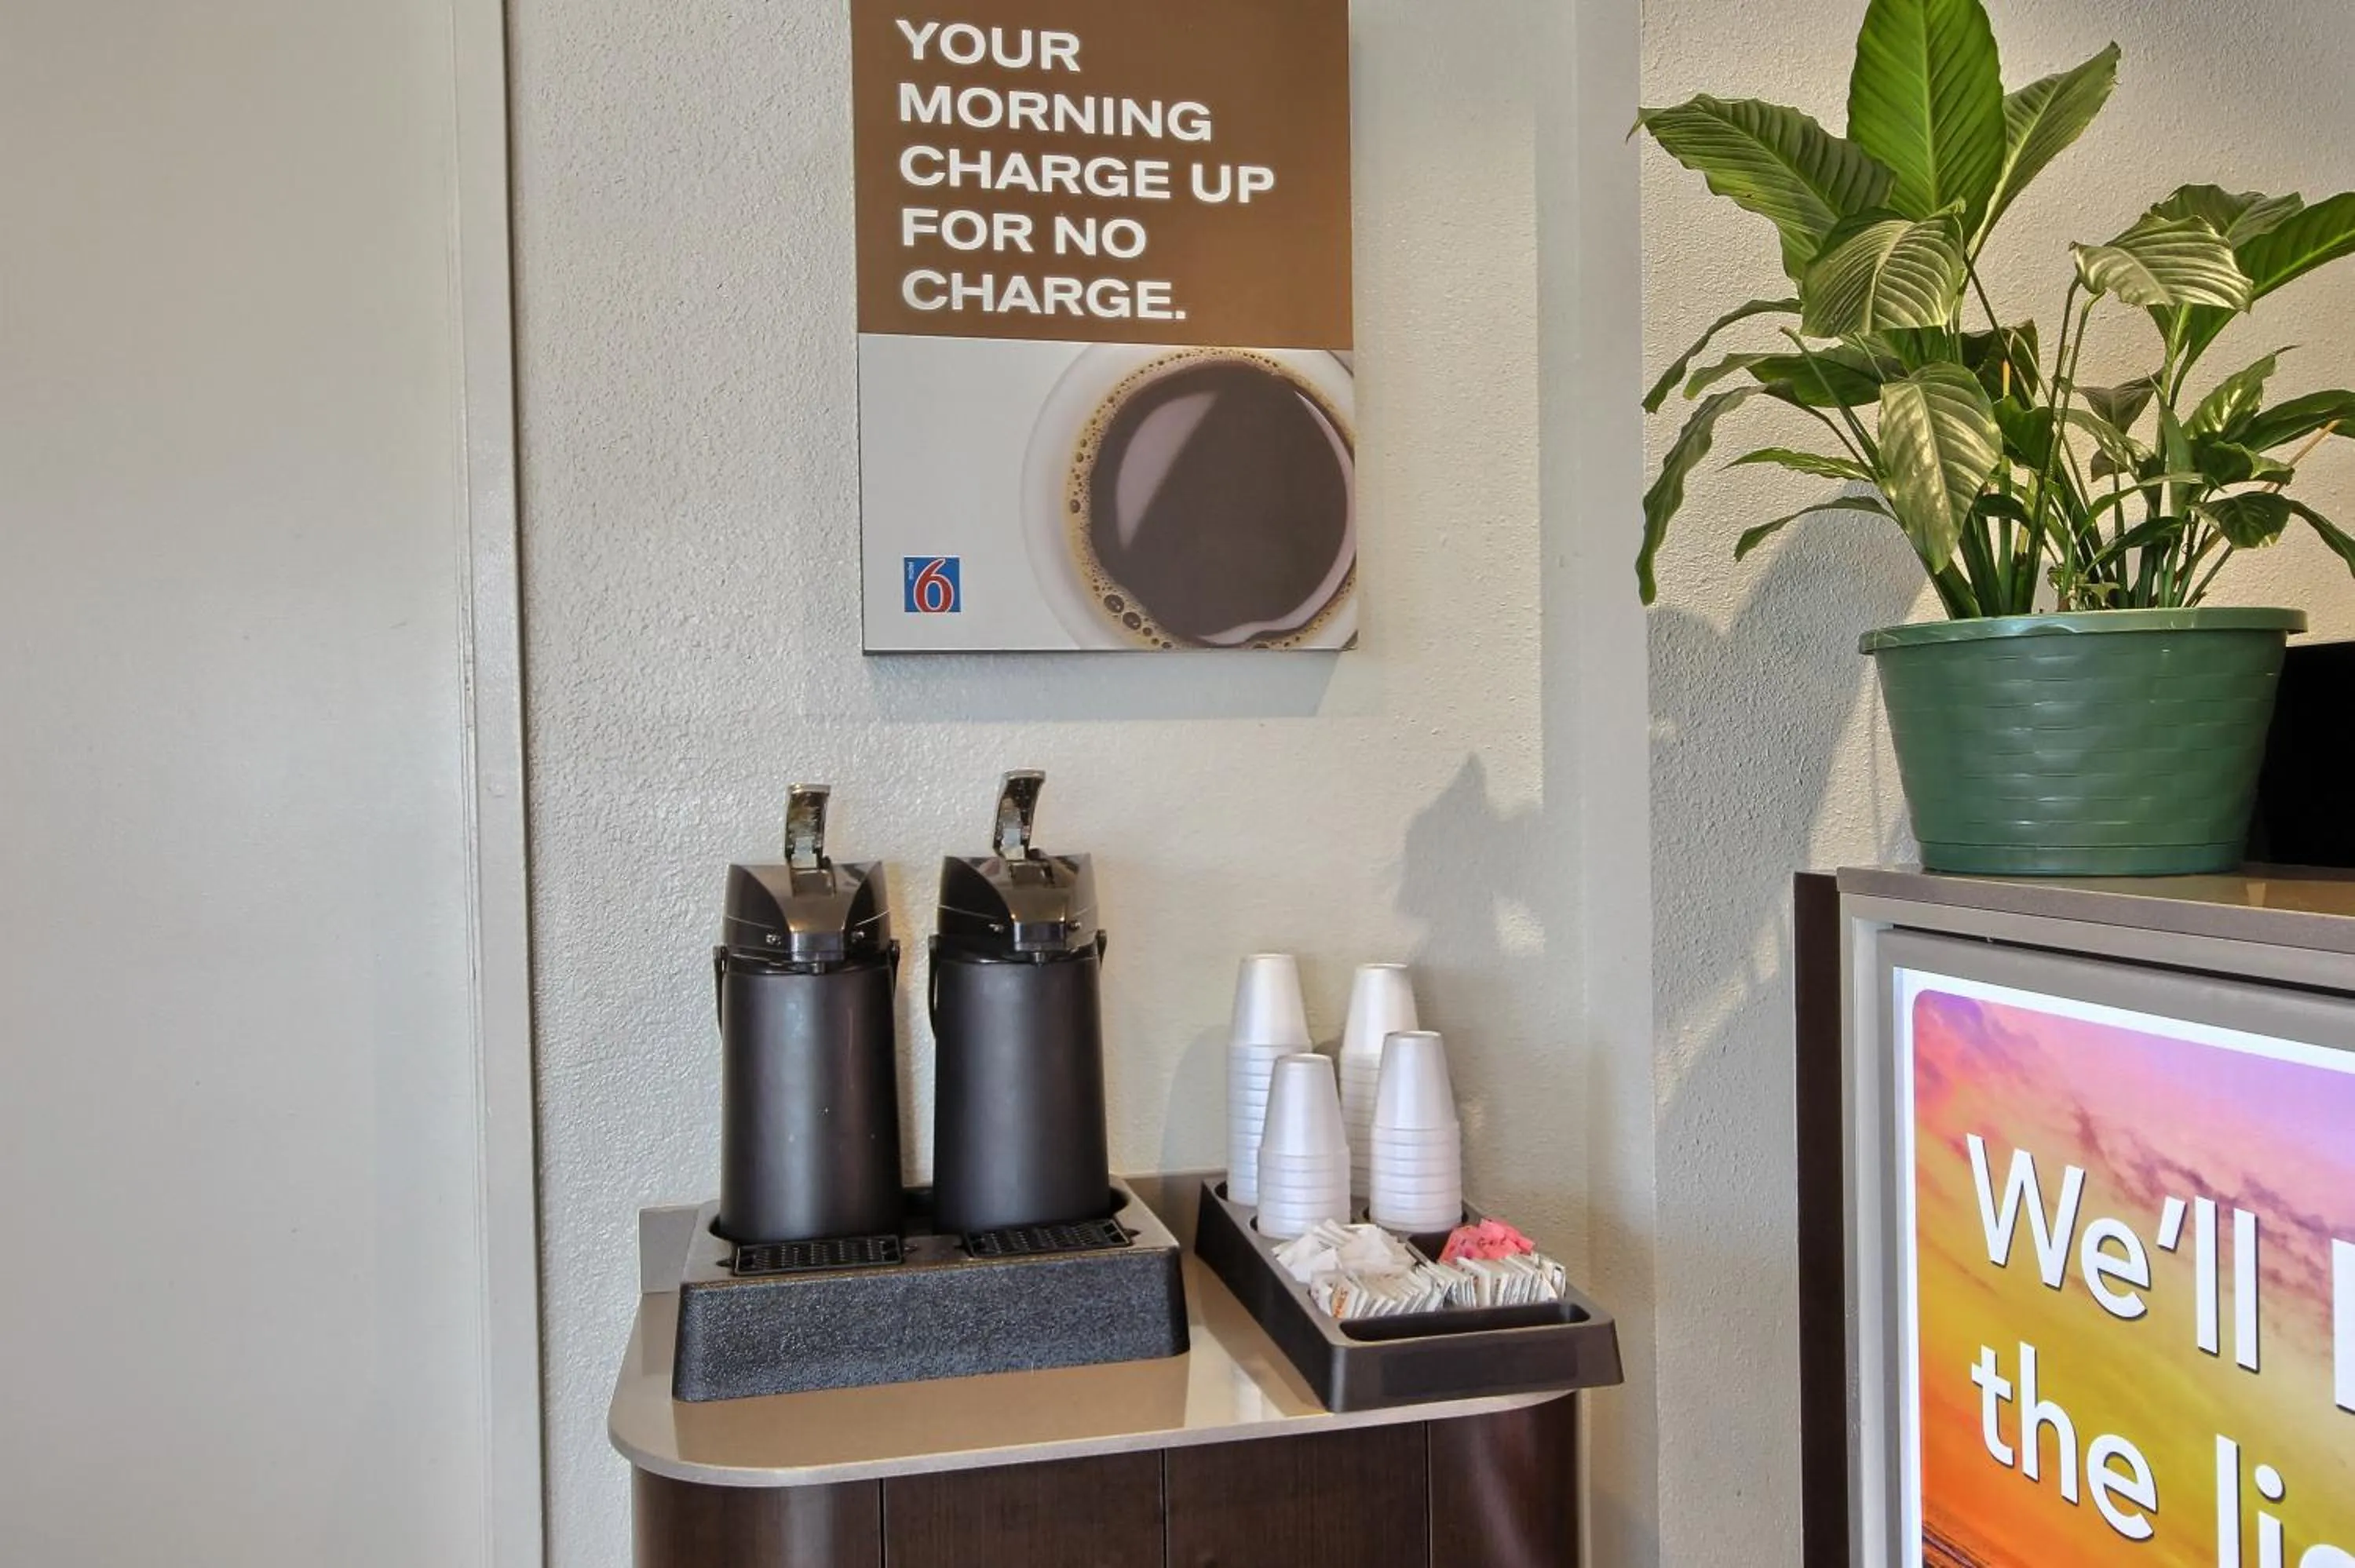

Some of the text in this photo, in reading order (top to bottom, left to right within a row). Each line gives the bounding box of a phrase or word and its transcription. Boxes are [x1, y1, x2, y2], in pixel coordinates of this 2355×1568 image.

[896, 19, 1081, 72] YOUR
[899, 82, 1212, 142] MORNING
[900, 145, 1275, 204] CHARGE UP
[902, 208, 1148, 259] FOR NO
[902, 269, 1187, 320] CHARGE.
[913, 558, 955, 614] 6
[1966, 1133, 2259, 1373] We'll
[1971, 1340, 2355, 1568] the li
